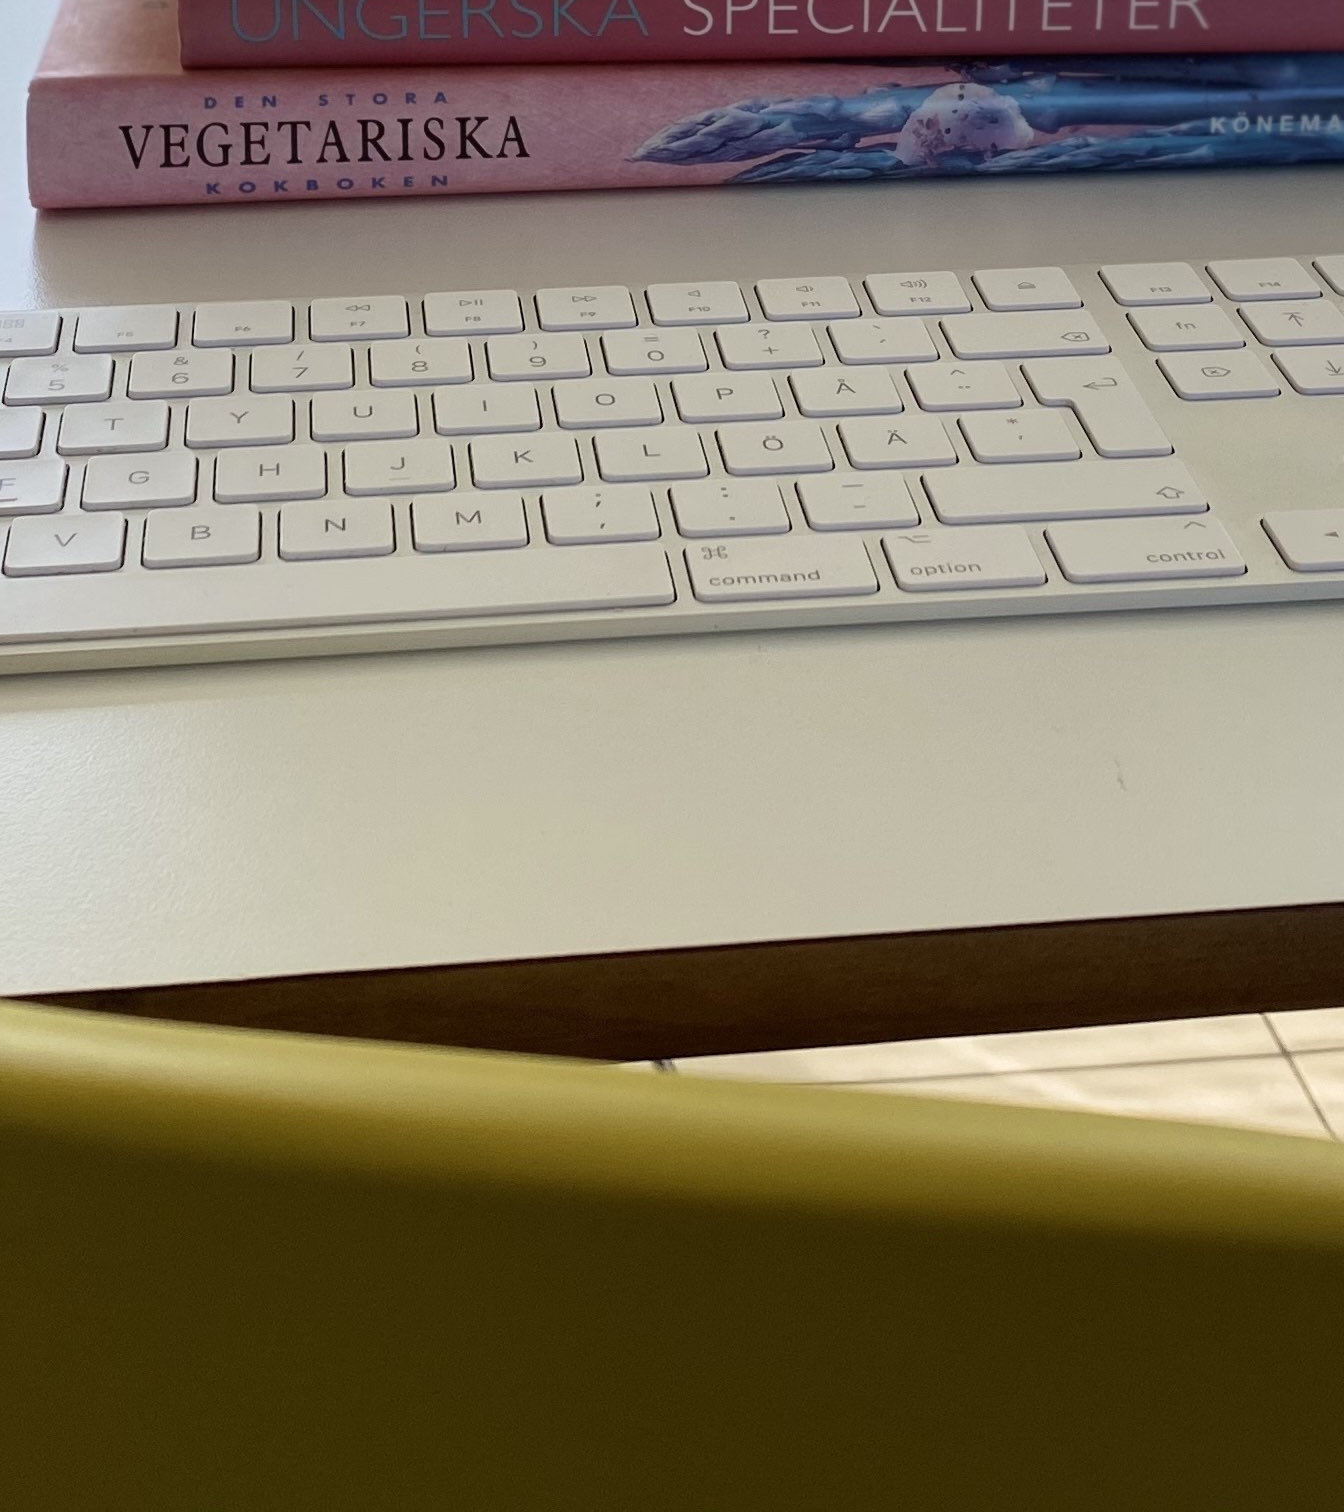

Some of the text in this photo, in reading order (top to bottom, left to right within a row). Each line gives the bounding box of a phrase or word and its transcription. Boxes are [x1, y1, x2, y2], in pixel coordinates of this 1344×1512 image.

[205, 92, 447, 109] DEN STORA
[119, 116, 530, 169] VEGETARISKA
[206, 176, 448, 193] KOKBOKEN
[1175, 321, 1197, 330] fn
[411, 360, 429, 373] 8
[529, 355, 547, 368] 9
[171, 372, 190, 384] 6
[293, 366, 309, 379] 7
[47, 379, 66, 392] 5
[836, 378, 857, 395] Å
[595, 393, 616, 406] O
[715, 388, 734, 400] P
[230, 411, 249, 424] Y
[353, 405, 373, 418] U
[105, 418, 124, 431] T
[762, 435, 784, 451] Ö
[887, 429, 907, 445] Ä
[513, 450, 533, 464] K
[642, 443, 661, 457] L
[259, 462, 280, 477] H
[390, 456, 406, 471] J
[128, 470, 150, 485] G
[324, 517, 346, 533] N
[455, 510, 482, 525] M
[54, 532, 78, 548] V
[190, 525, 212, 540] B
[1146, 548, 1226, 563] control
[709, 569, 821, 586] command
[910, 563, 982, 577] option
